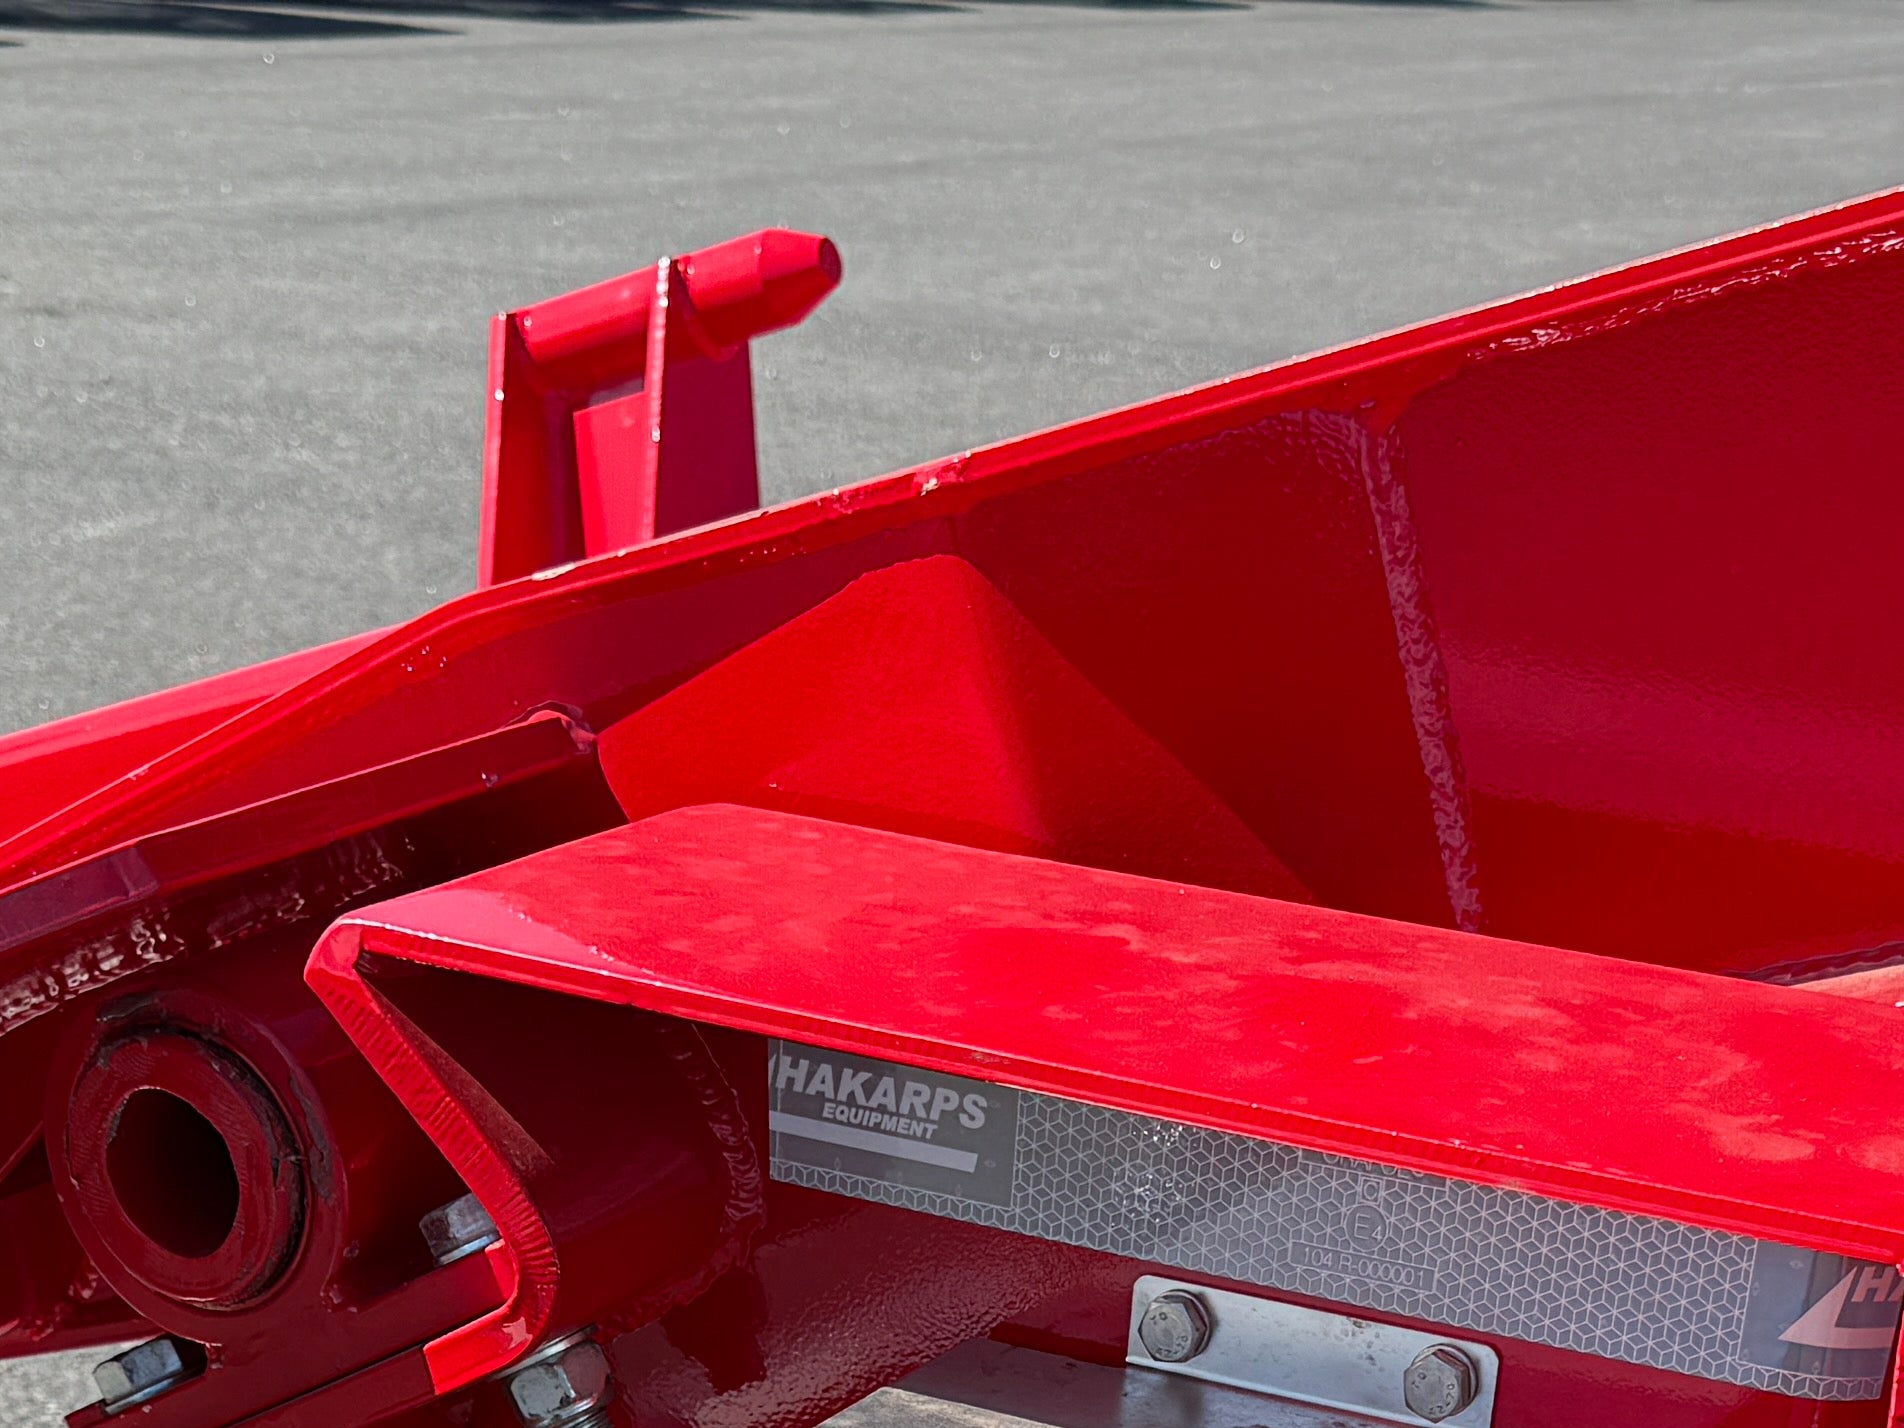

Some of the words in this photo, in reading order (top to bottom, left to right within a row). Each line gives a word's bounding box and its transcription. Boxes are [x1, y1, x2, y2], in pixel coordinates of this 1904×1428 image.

[776, 1055, 988, 1129] HAKARPS
[822, 1102, 938, 1139] EQUIPMENT
[1304, 1247, 1333, 1267] 104
